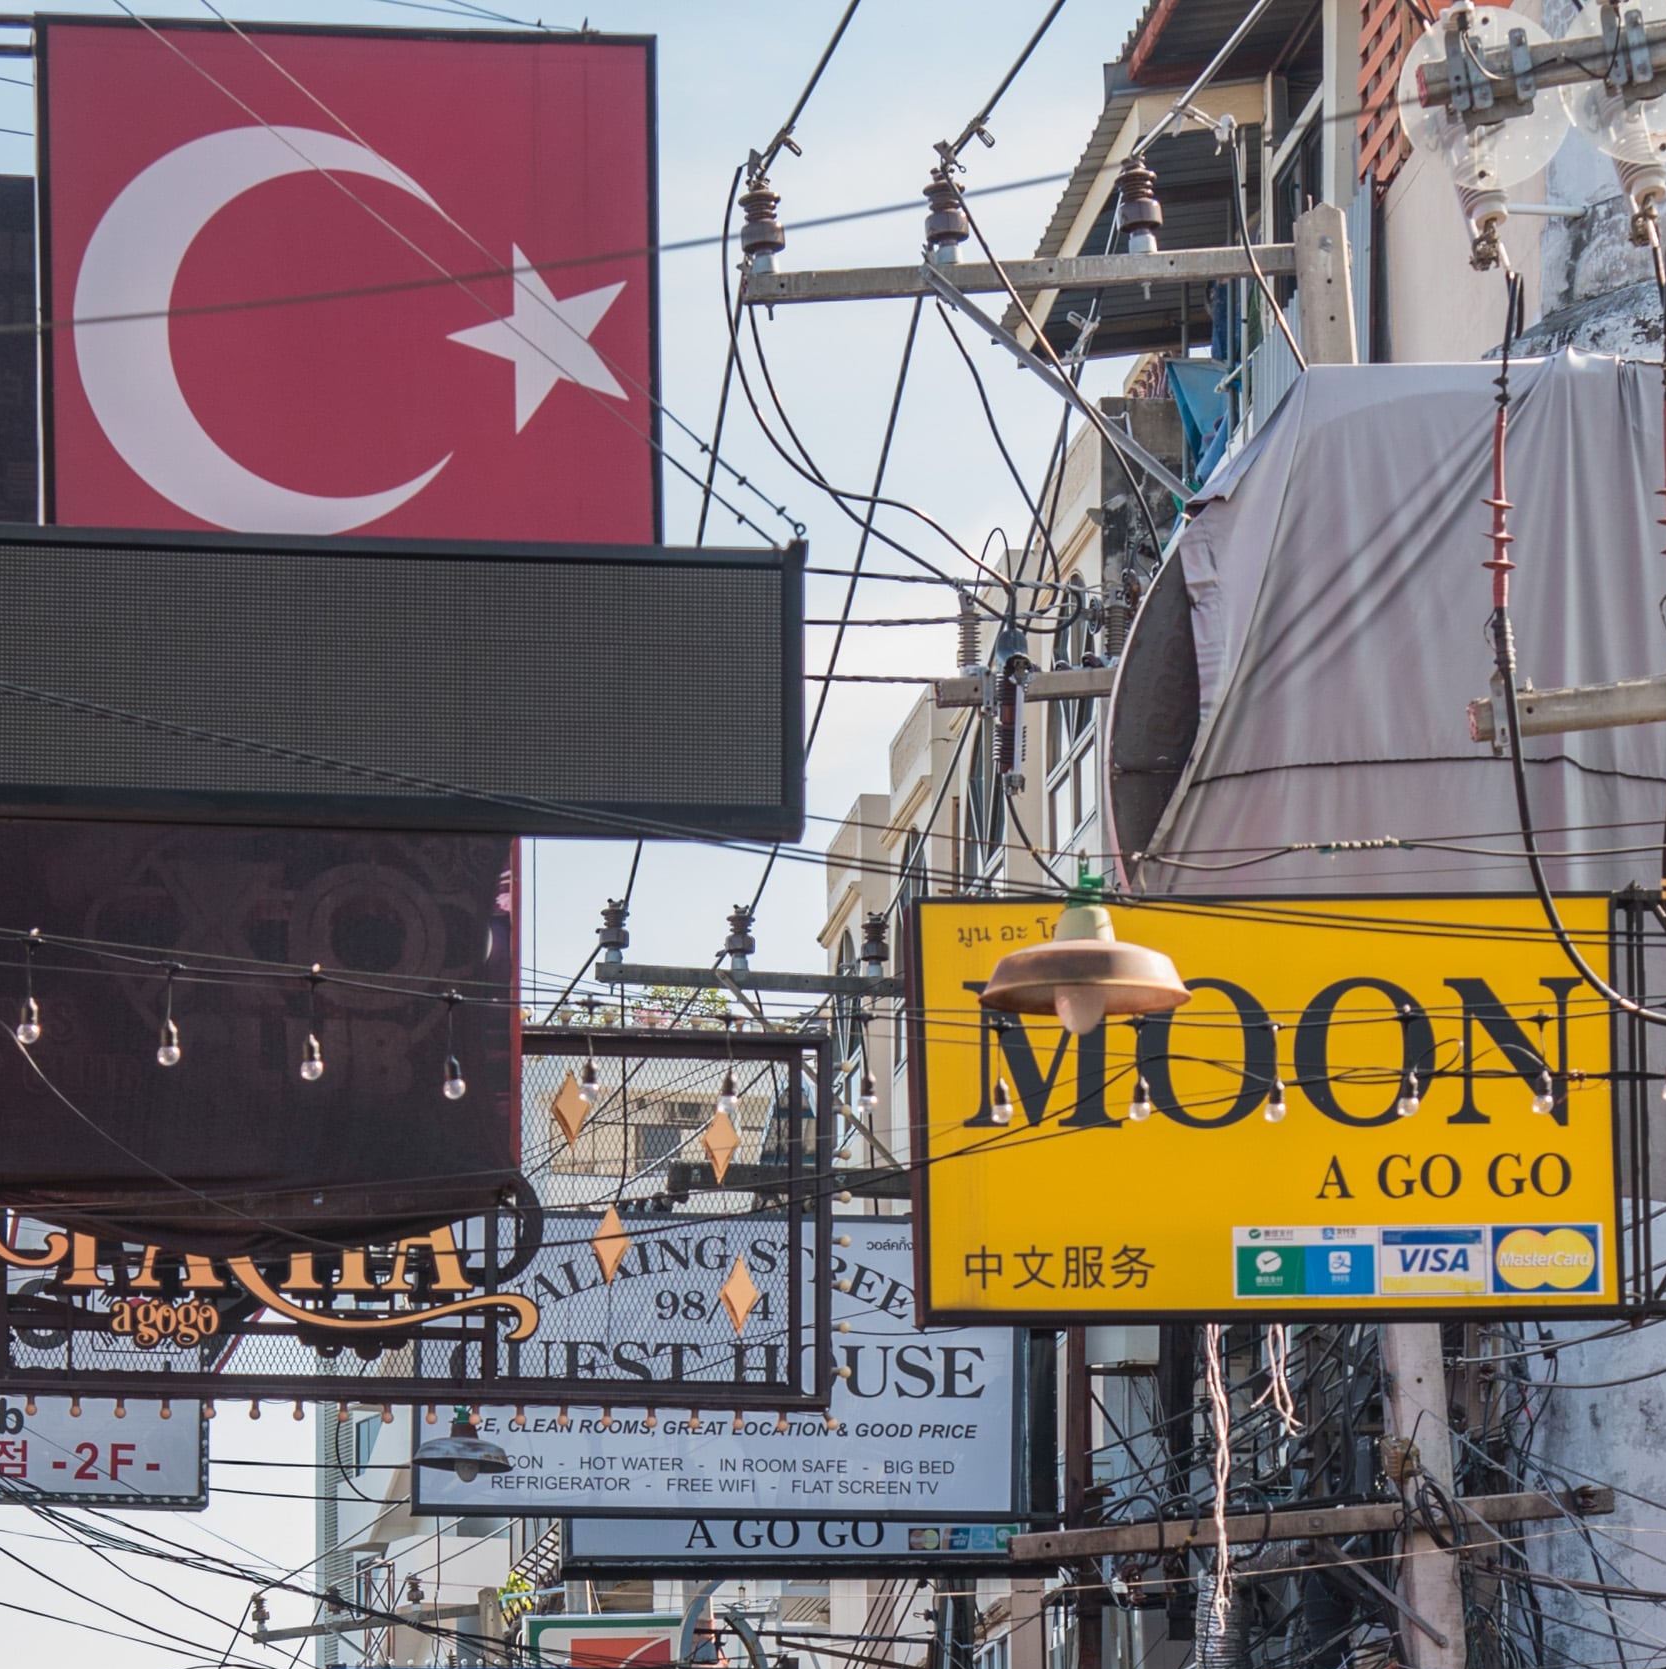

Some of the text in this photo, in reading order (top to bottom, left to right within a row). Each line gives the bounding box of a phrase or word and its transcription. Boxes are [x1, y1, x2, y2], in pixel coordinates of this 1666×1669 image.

[957, 926, 991, 948] มูน
[962, 976, 1583, 1129] MOON
[1317, 1152, 1573, 1199] A GO GO
[964, 1244, 1157, 1291] 中文服务
[1399, 1247, 1591, 1273] VISA MasterCard
[508, 1418, 978, 1439] CLEAN ROOMS, GREAT LOCATION & GOOD PRICE
[580, 1457, 618, 1471] HOT
[621, 1457, 684, 1472] WATER
[720, 1459, 737, 1472] IN
[742, 1459, 797, 1473] ROOM
[802, 1459, 848, 1473] SAFE
[884, 1460, 913, 1474] BIG
[919, 1460, 955, 1475] BED
[491, 1475, 939, 1495] REFRIGERATOR FREE WIFI FLAT SCREEN TV
[733, 1518, 800, 1549] GO
[817, 1519, 885, 1549] GO
